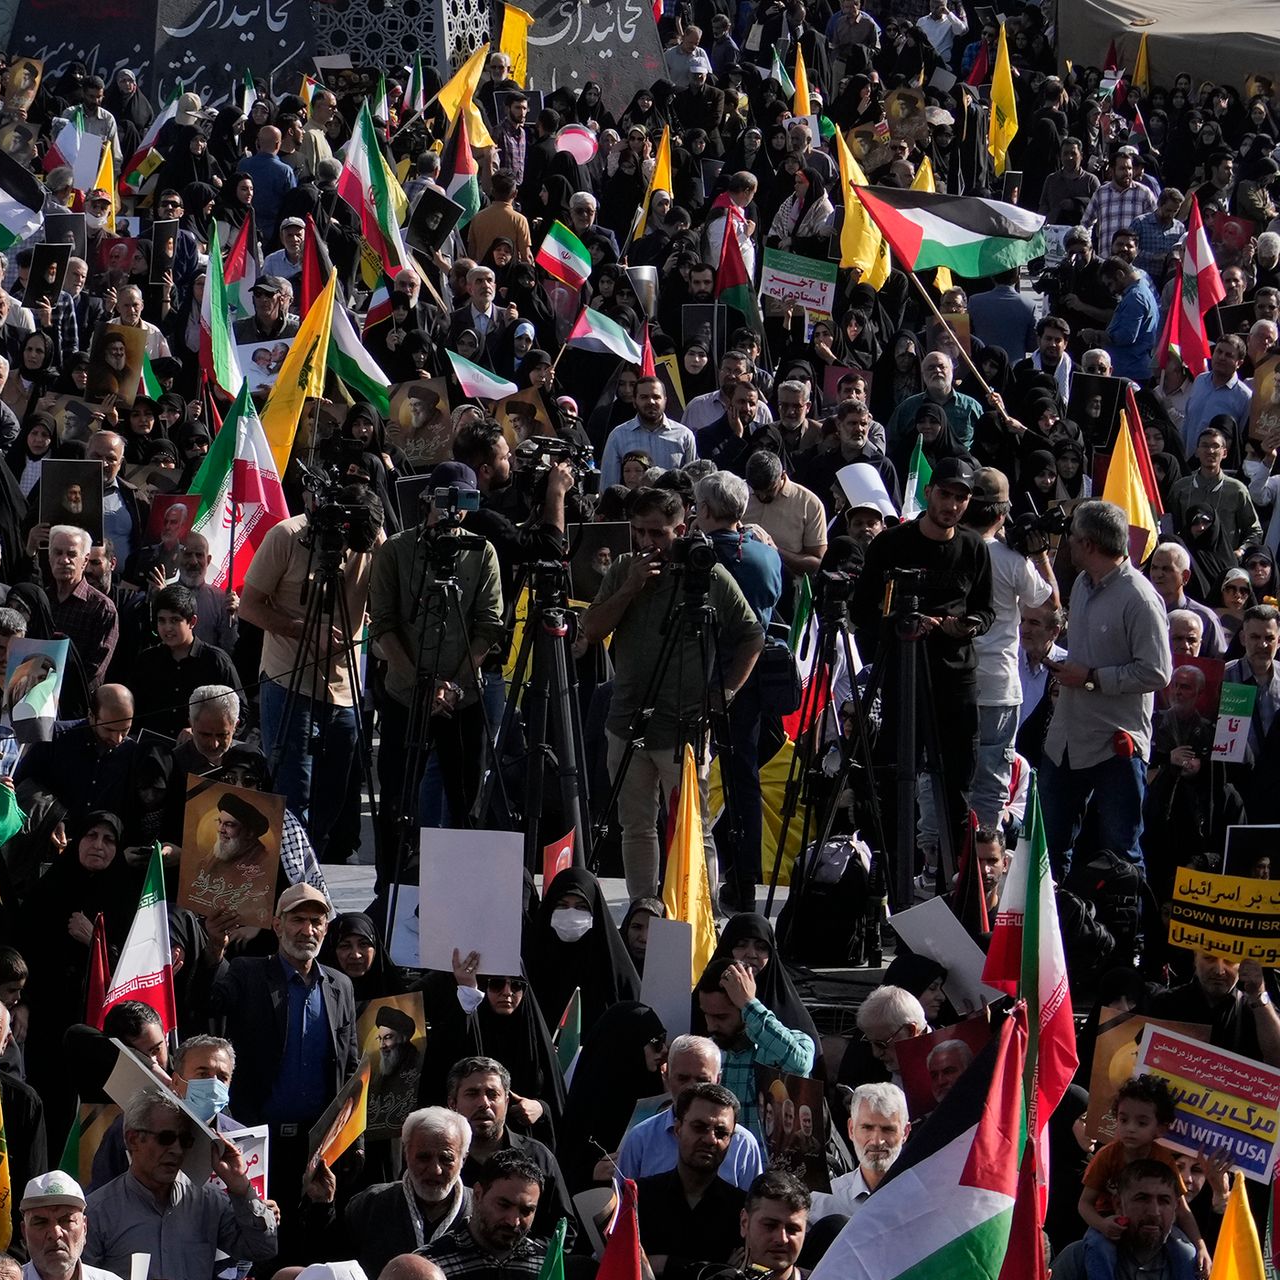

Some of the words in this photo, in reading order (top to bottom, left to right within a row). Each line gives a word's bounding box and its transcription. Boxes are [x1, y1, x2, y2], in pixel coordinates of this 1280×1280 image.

[768, 275, 815, 289] آخر
[820, 282, 829, 293] تا
[1228, 717, 1240, 733] تا
[1179, 879, 1240, 904] اسرائیل
[1245, 894, 1263, 909] بر
[1173, 905, 1215, 923] DOWN
[1219, 915, 1254, 930] WITH
[1205, 1101, 1228, 1121] بر
[1229, 1105, 1277, 1134] مرگ
[1191, 1124, 1234, 1152] WITH
[1235, 1138, 1267, 1164] USA
[244, 1153, 259, 1175] مر
